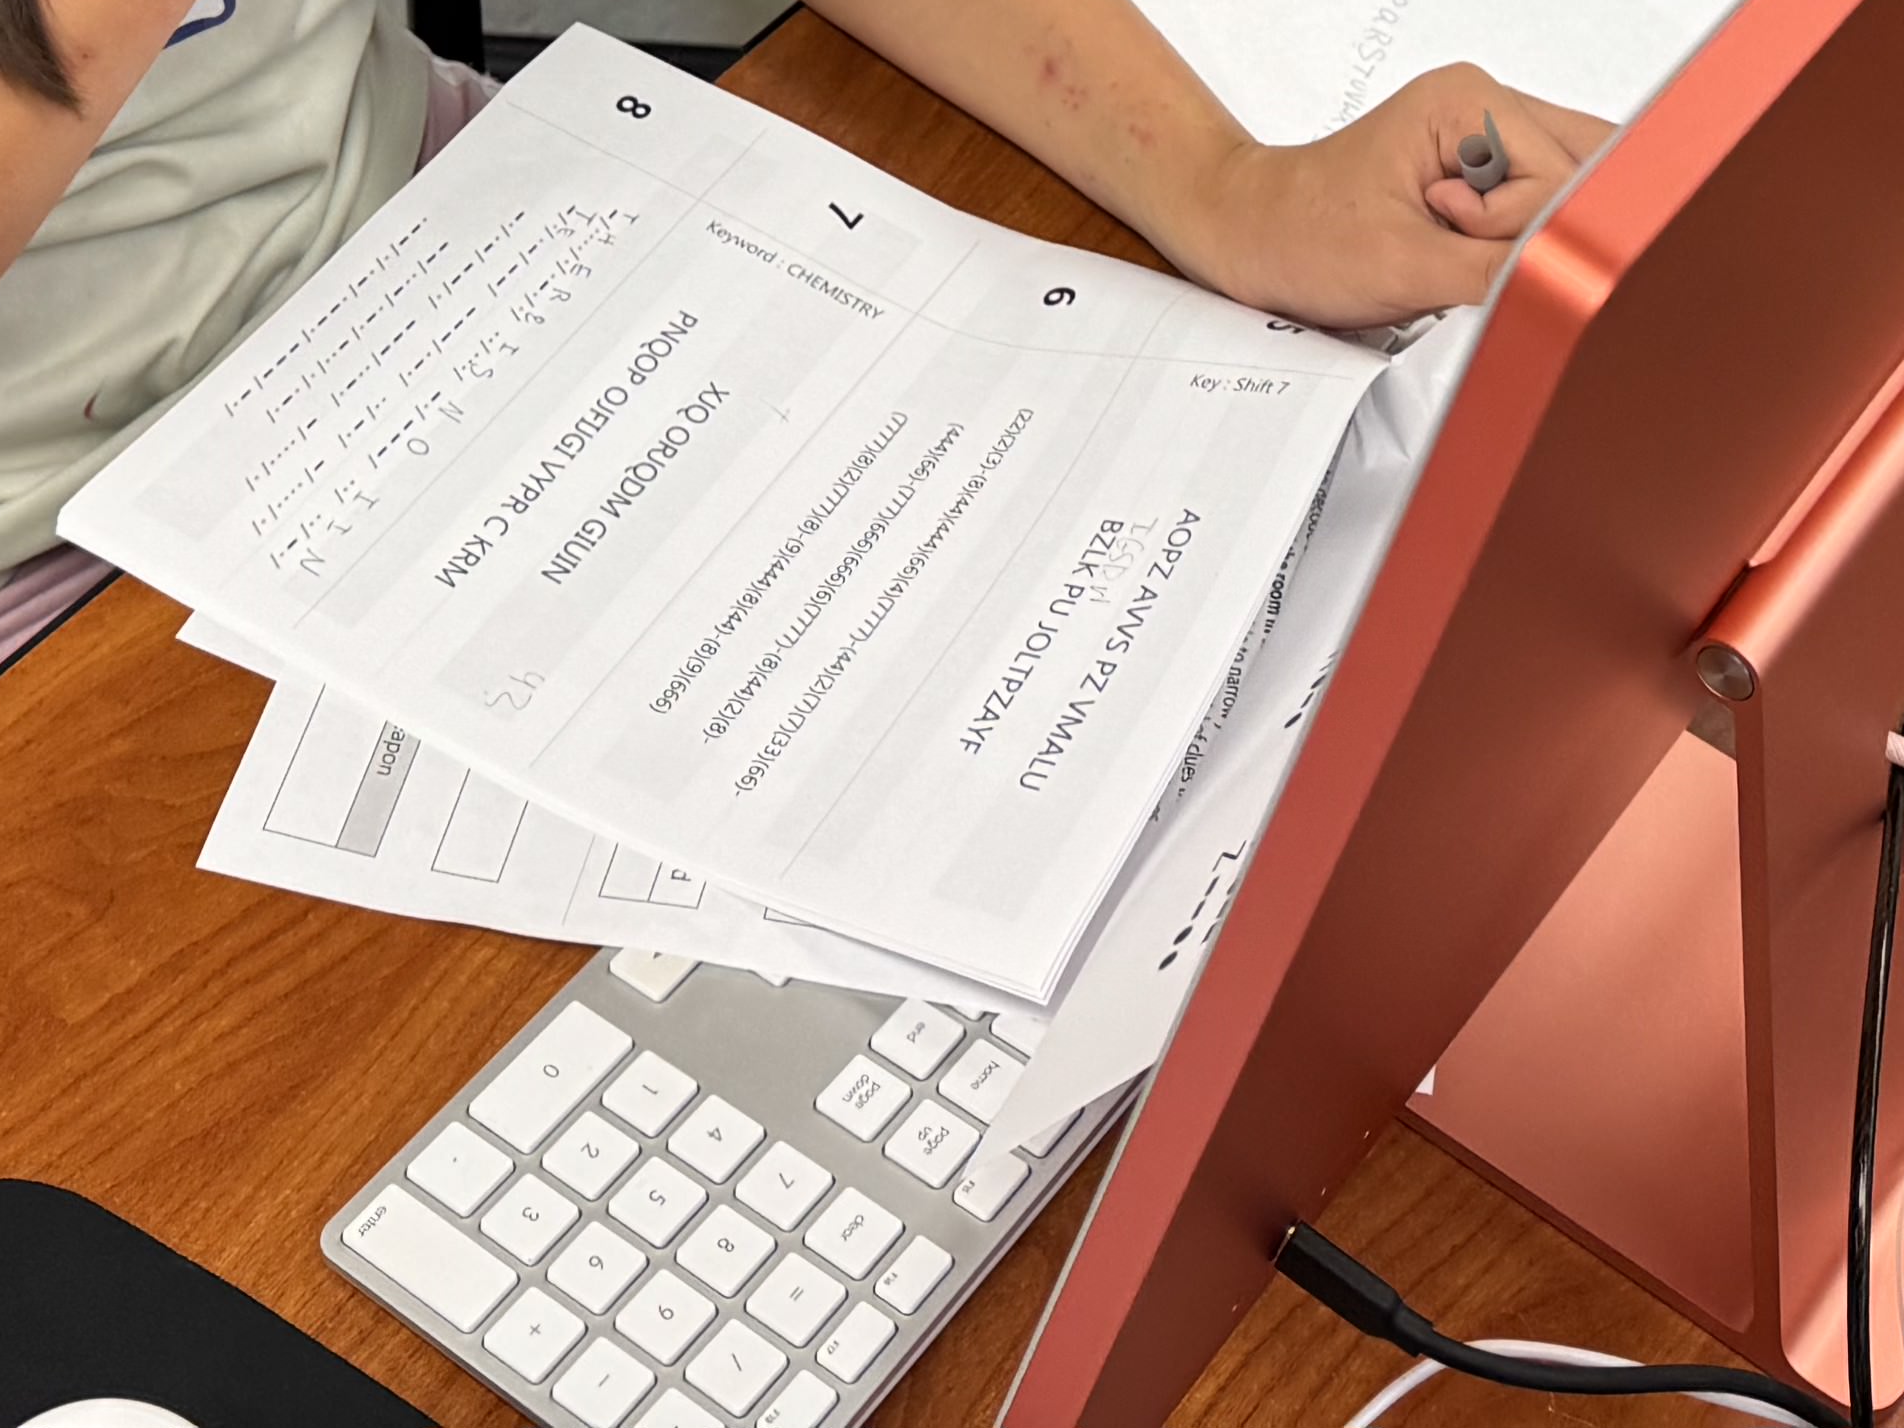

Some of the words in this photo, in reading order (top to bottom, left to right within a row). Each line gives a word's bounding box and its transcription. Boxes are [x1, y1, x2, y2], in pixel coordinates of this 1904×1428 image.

[615, 95, 652, 120] 8
[828, 202, 864, 230] 7
[705, 220, 778, 264] Keyword
[786, 263, 884, 319] CHEMISTRY
[1043, 287, 1076, 306] 6
[628, 310, 698, 386] PNQOP
[1189, 374, 1222, 393] Key
[1232, 377, 1273, 394] Shift
[676, 381, 730, 424] XJQ
[500, 460, 565, 515] VYPR
[600, 425, 690, 518] ORJQDM
[483, 515, 509, 537] C
[434, 534, 493, 588] KRM
[541, 519, 607, 584] GIUIN
[1071, 519, 1124, 578] BZLK
[1146, 508, 1201, 580] AOPZ
[1049, 583, 1086, 617] PU
[1266, 572, 1286, 616] room
[1105, 584, 1158, 653] AVVS
[960, 621, 1057, 754] JOLTPZAYF
[1079, 659, 1118, 693] PZ
[1019, 700, 1094, 791] VMALU
[1180, 742, 1204, 783] clues
[543, 1064, 560, 1078] 0
[642, 1083, 659, 1096] 1
[580, 1142, 600, 1159] 2
[706, 1127, 723, 1143] 4
[778, 1171, 796, 1190] 7
[521, 1205, 540, 1223] 3
[648, 1189, 667, 1207] 5
[357, 1204, 388, 1238] enter
[716, 1237, 735, 1253] 8
[588, 1254, 605, 1271] 6
[658, 1304, 675, 1321] 9
